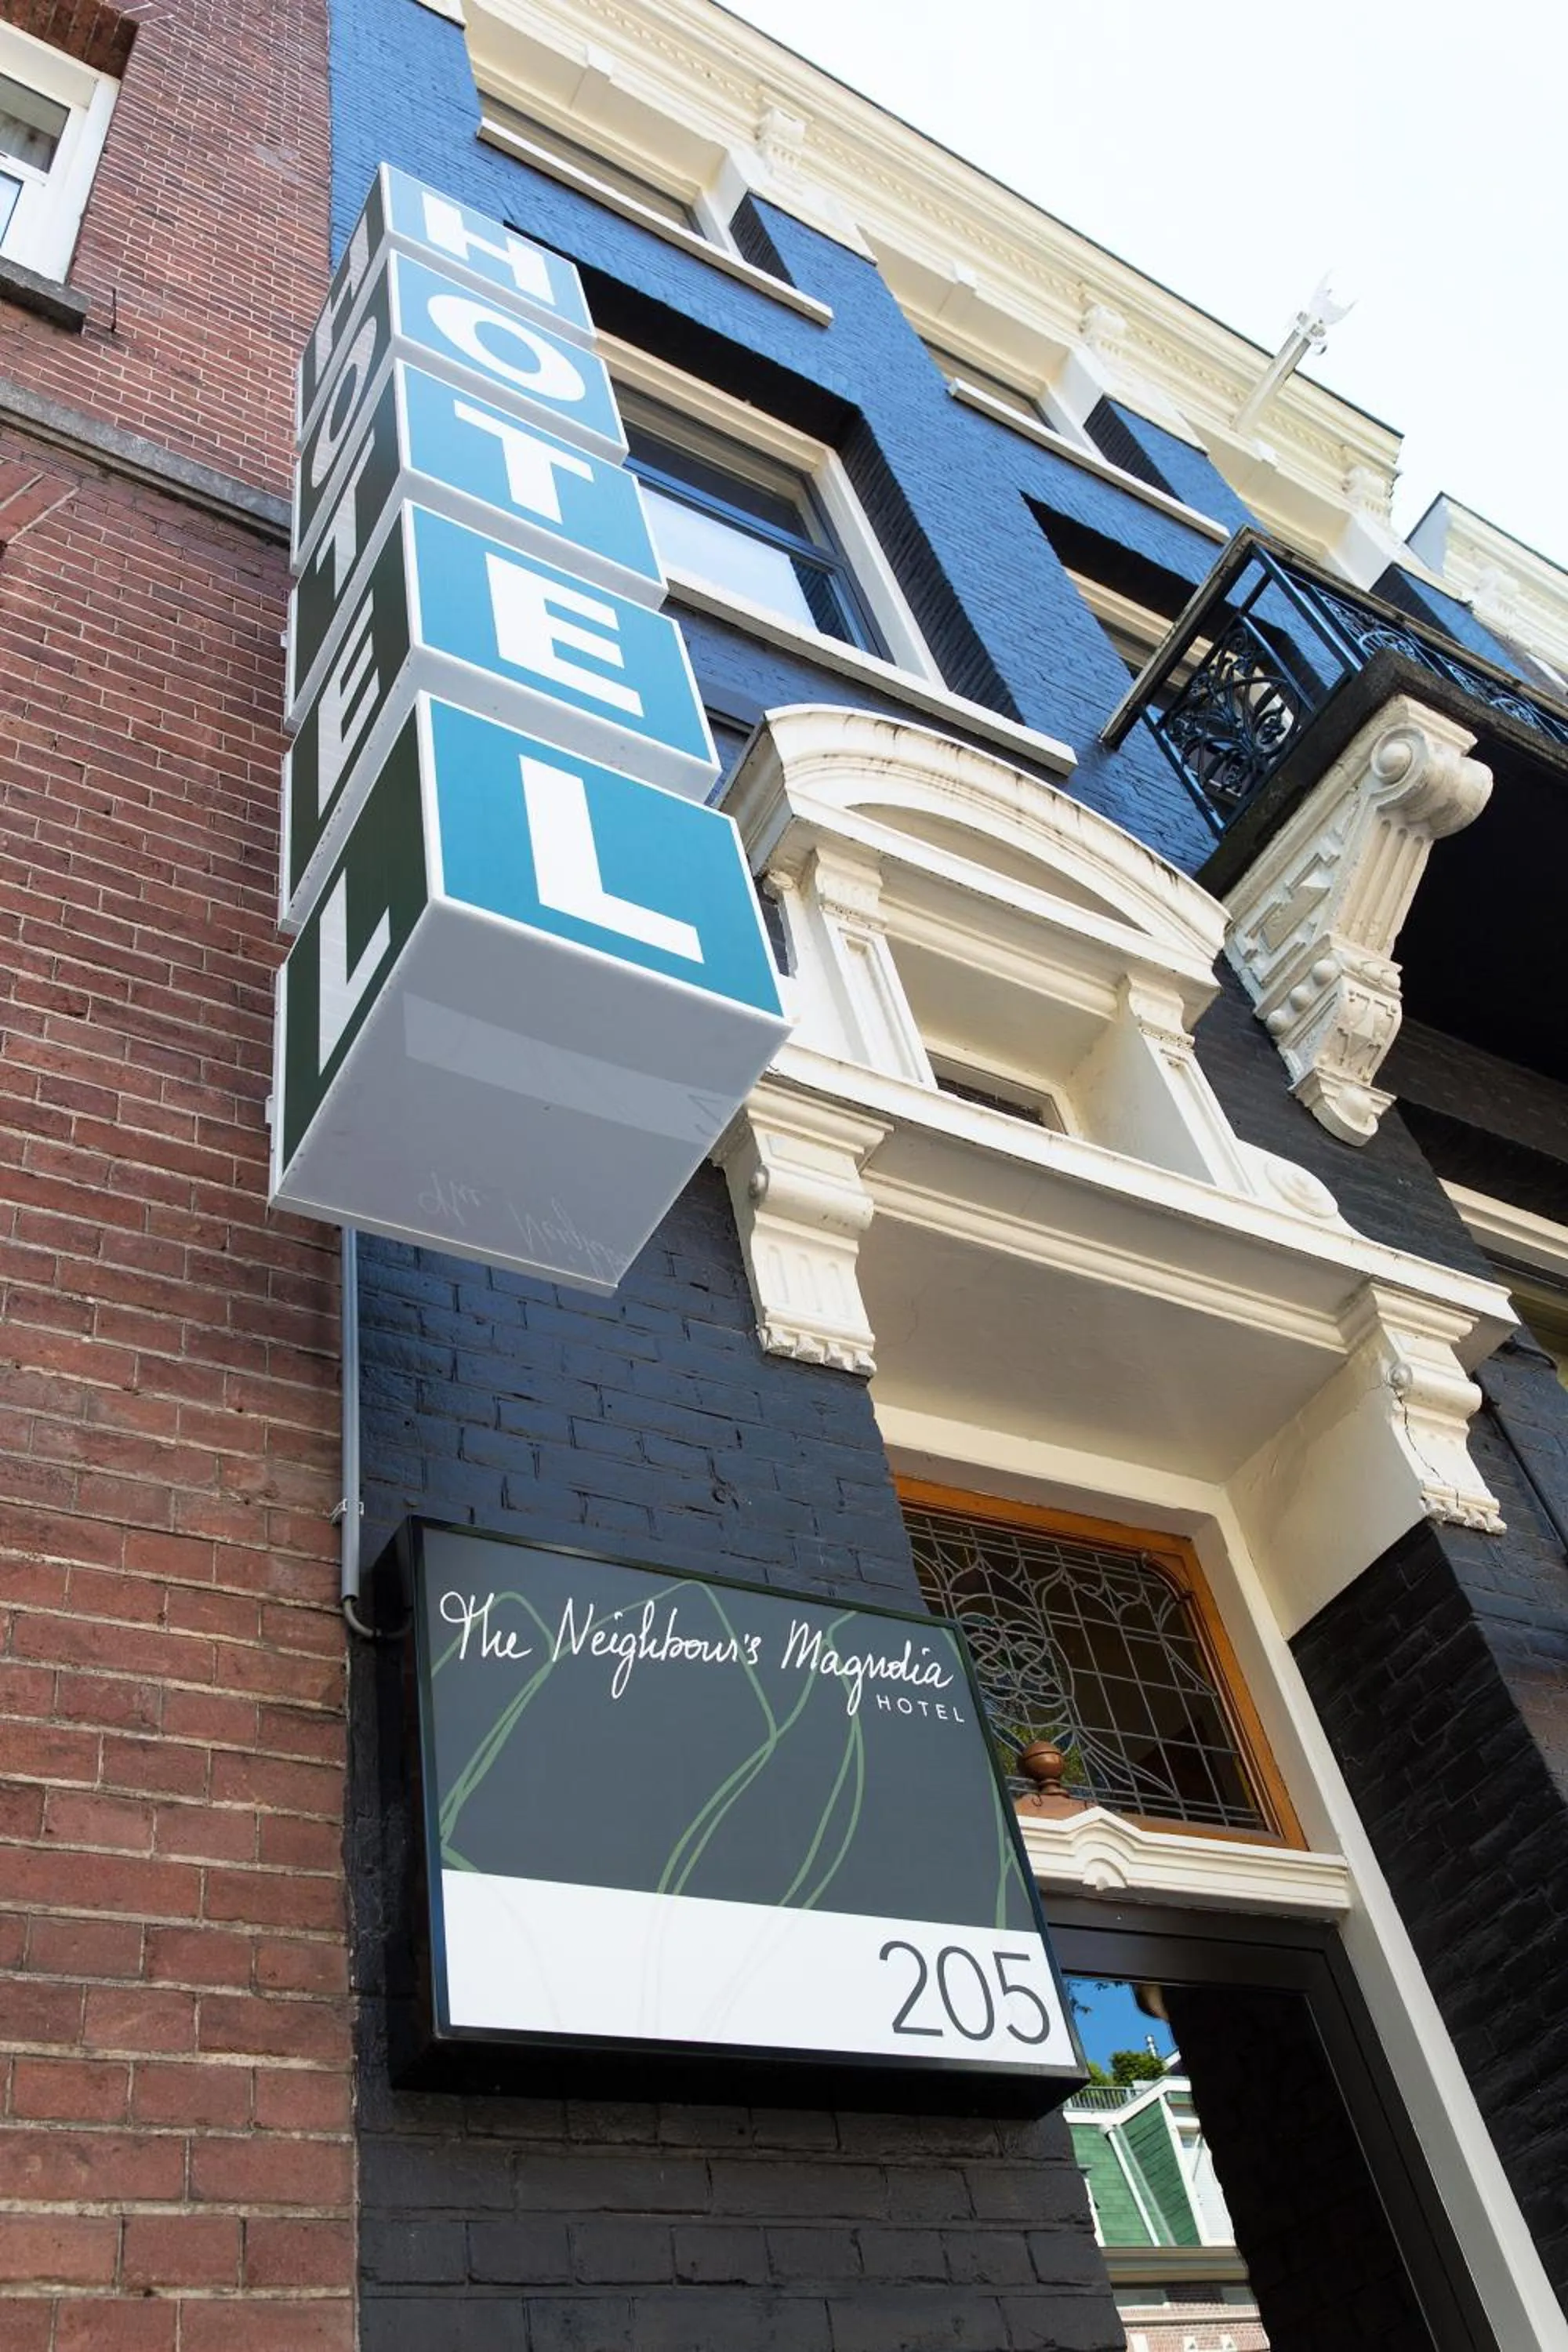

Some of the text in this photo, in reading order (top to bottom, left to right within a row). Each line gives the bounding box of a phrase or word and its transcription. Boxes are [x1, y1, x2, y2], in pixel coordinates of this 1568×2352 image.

[422, 191, 705, 964] HOTEL
[311, 210, 391, 1076] HOTEL
[440, 1591, 954, 1716] The Neighbour's Magnolia
[876, 1694, 964, 1722] HOTEL
[879, 1940, 1051, 2045] 205
